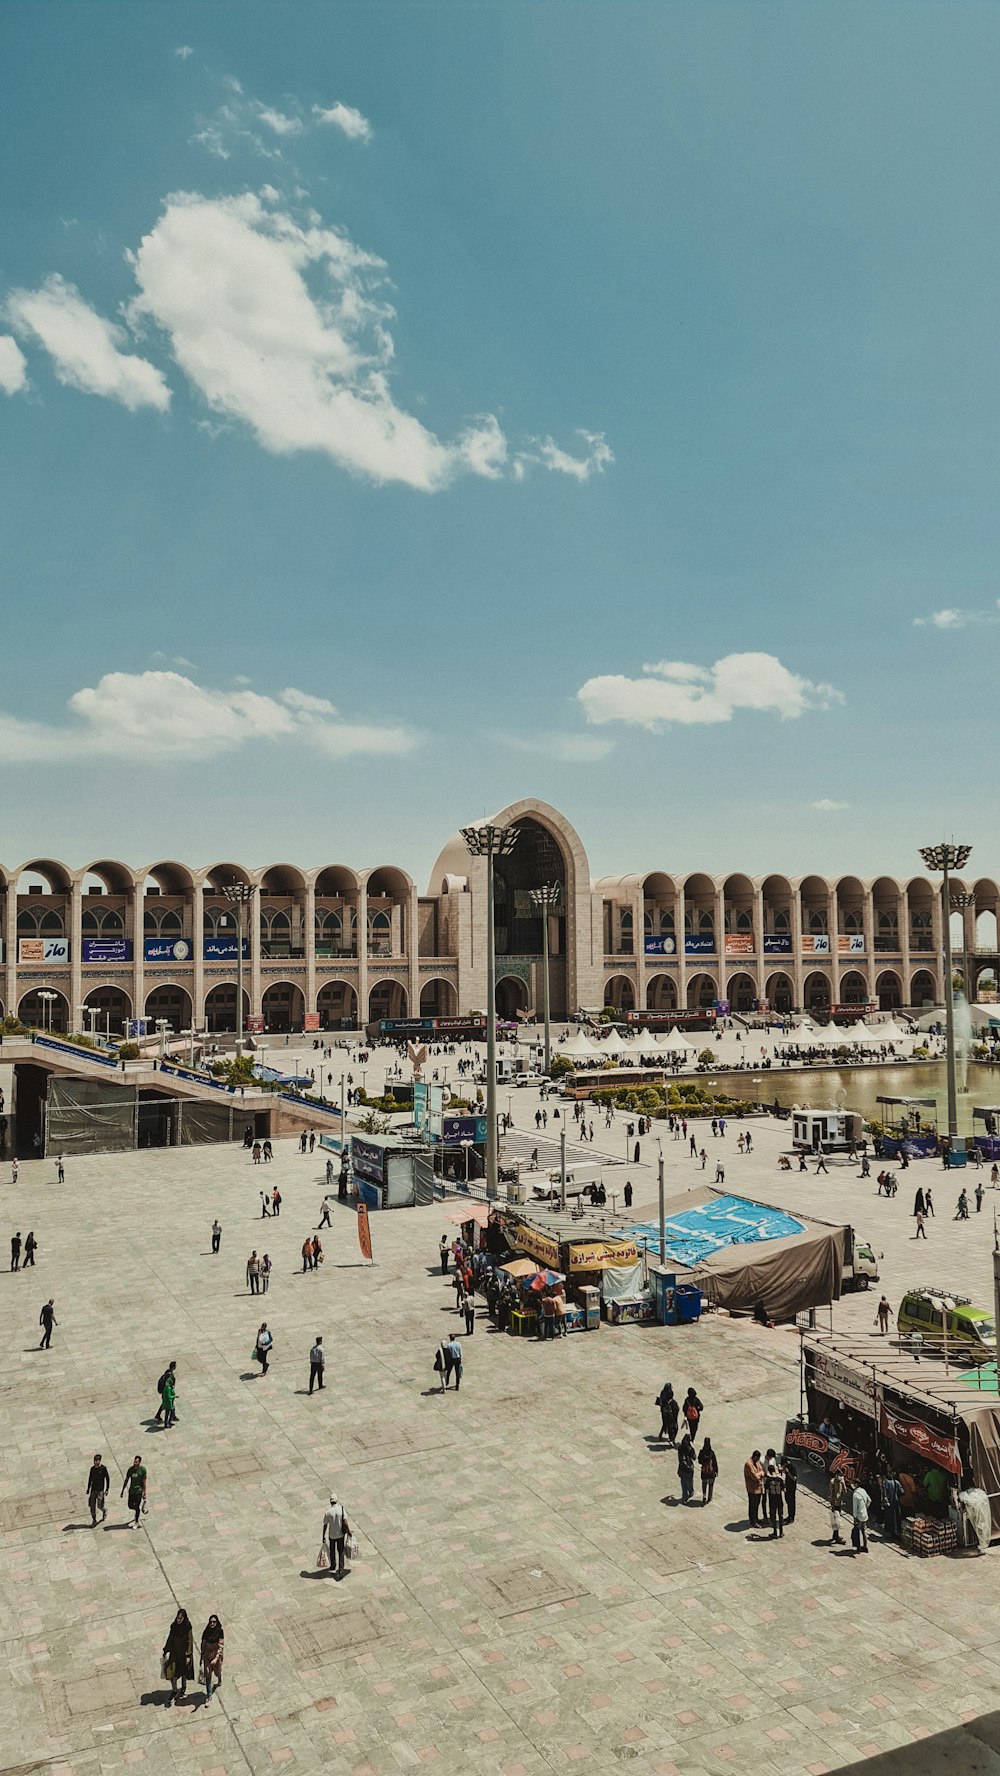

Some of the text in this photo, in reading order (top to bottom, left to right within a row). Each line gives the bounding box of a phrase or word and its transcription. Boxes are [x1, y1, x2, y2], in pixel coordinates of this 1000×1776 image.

[815, 939, 828, 949] ماز
[851, 939, 863, 949] ماز
[45, 944, 66, 957] ماز
[570, 1247, 636, 1264] فالوده بستنی شیرازی
